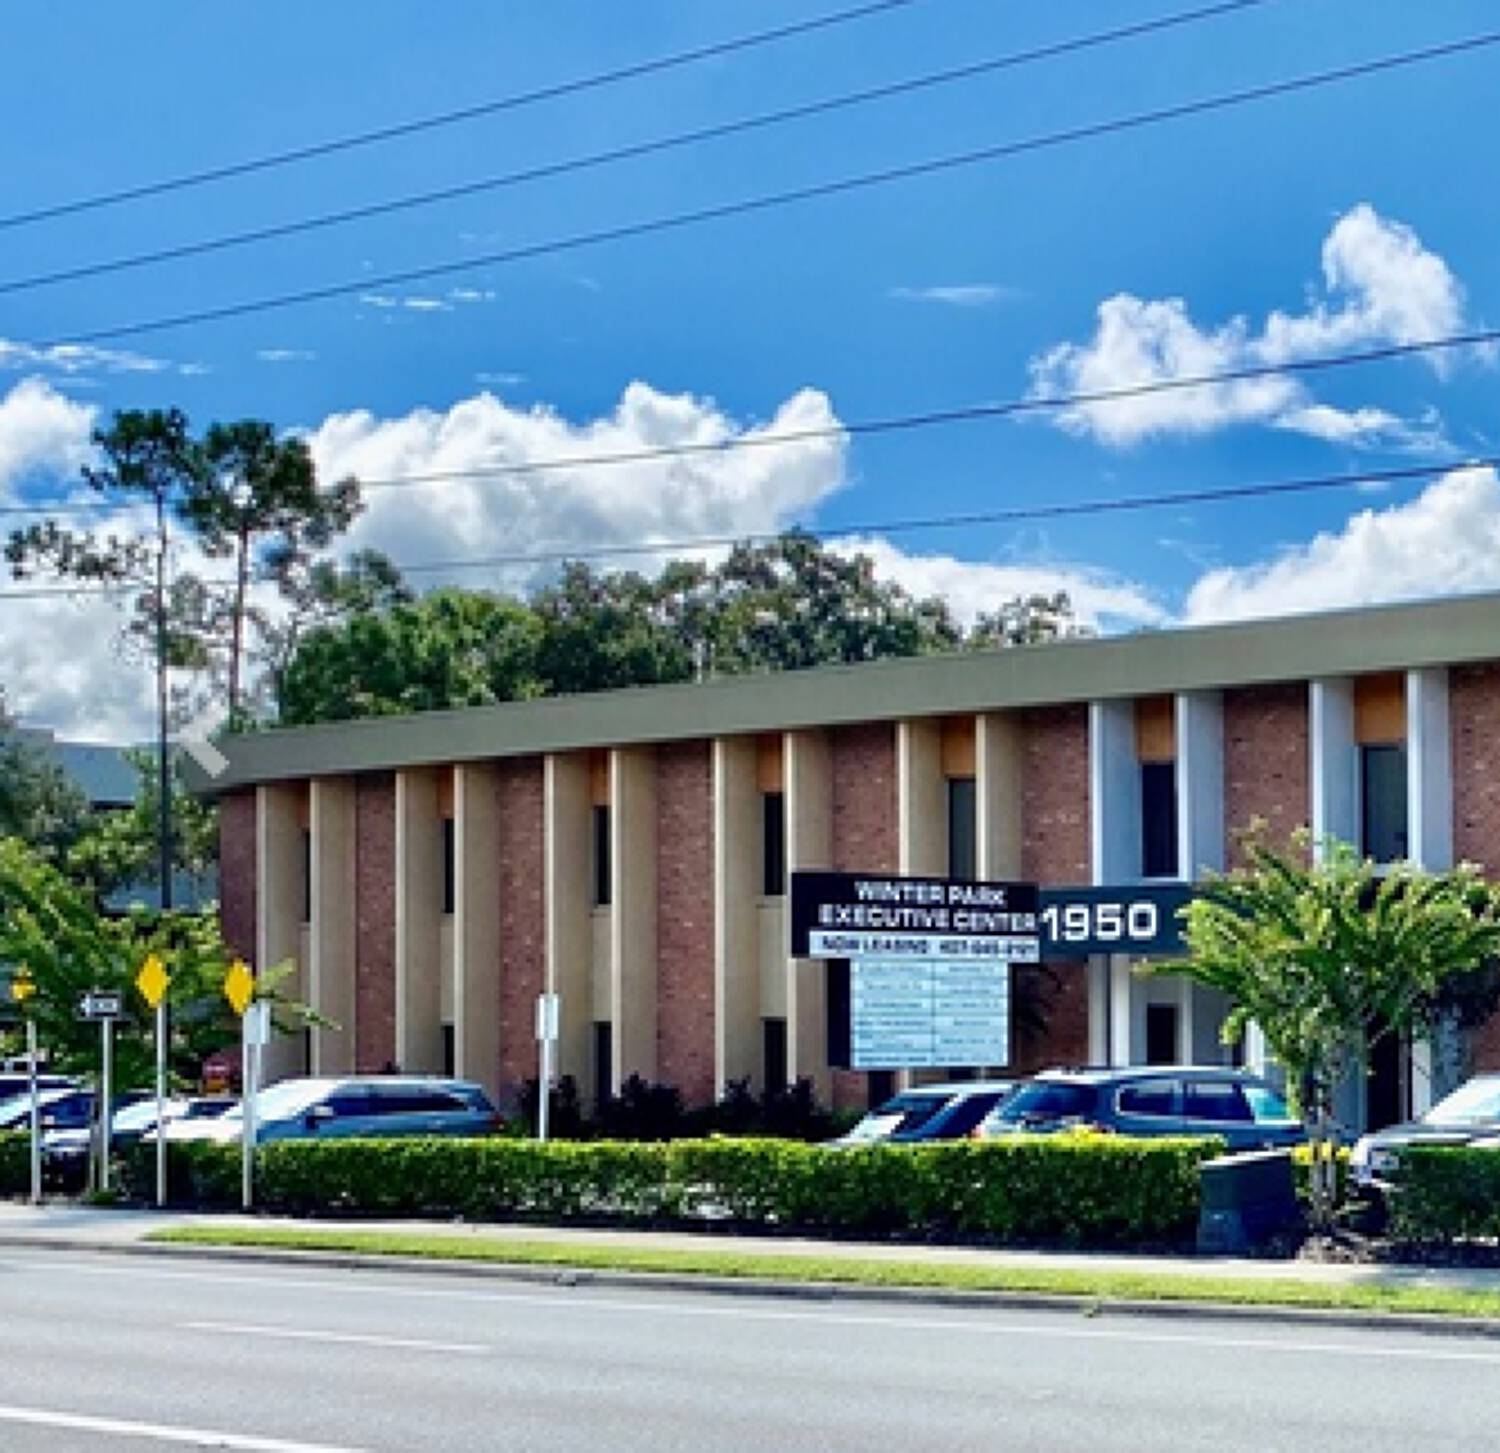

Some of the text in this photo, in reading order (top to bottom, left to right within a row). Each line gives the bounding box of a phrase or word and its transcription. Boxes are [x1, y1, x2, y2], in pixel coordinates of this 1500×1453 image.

[854, 881, 1005, 905] WINTER PARK
[818, 904, 1036, 931] EXECUTIVE CENTER
[1042, 902, 1157, 941] 1950
[822, 934, 860, 951] NOW
[864, 935, 929, 954] LEASING
